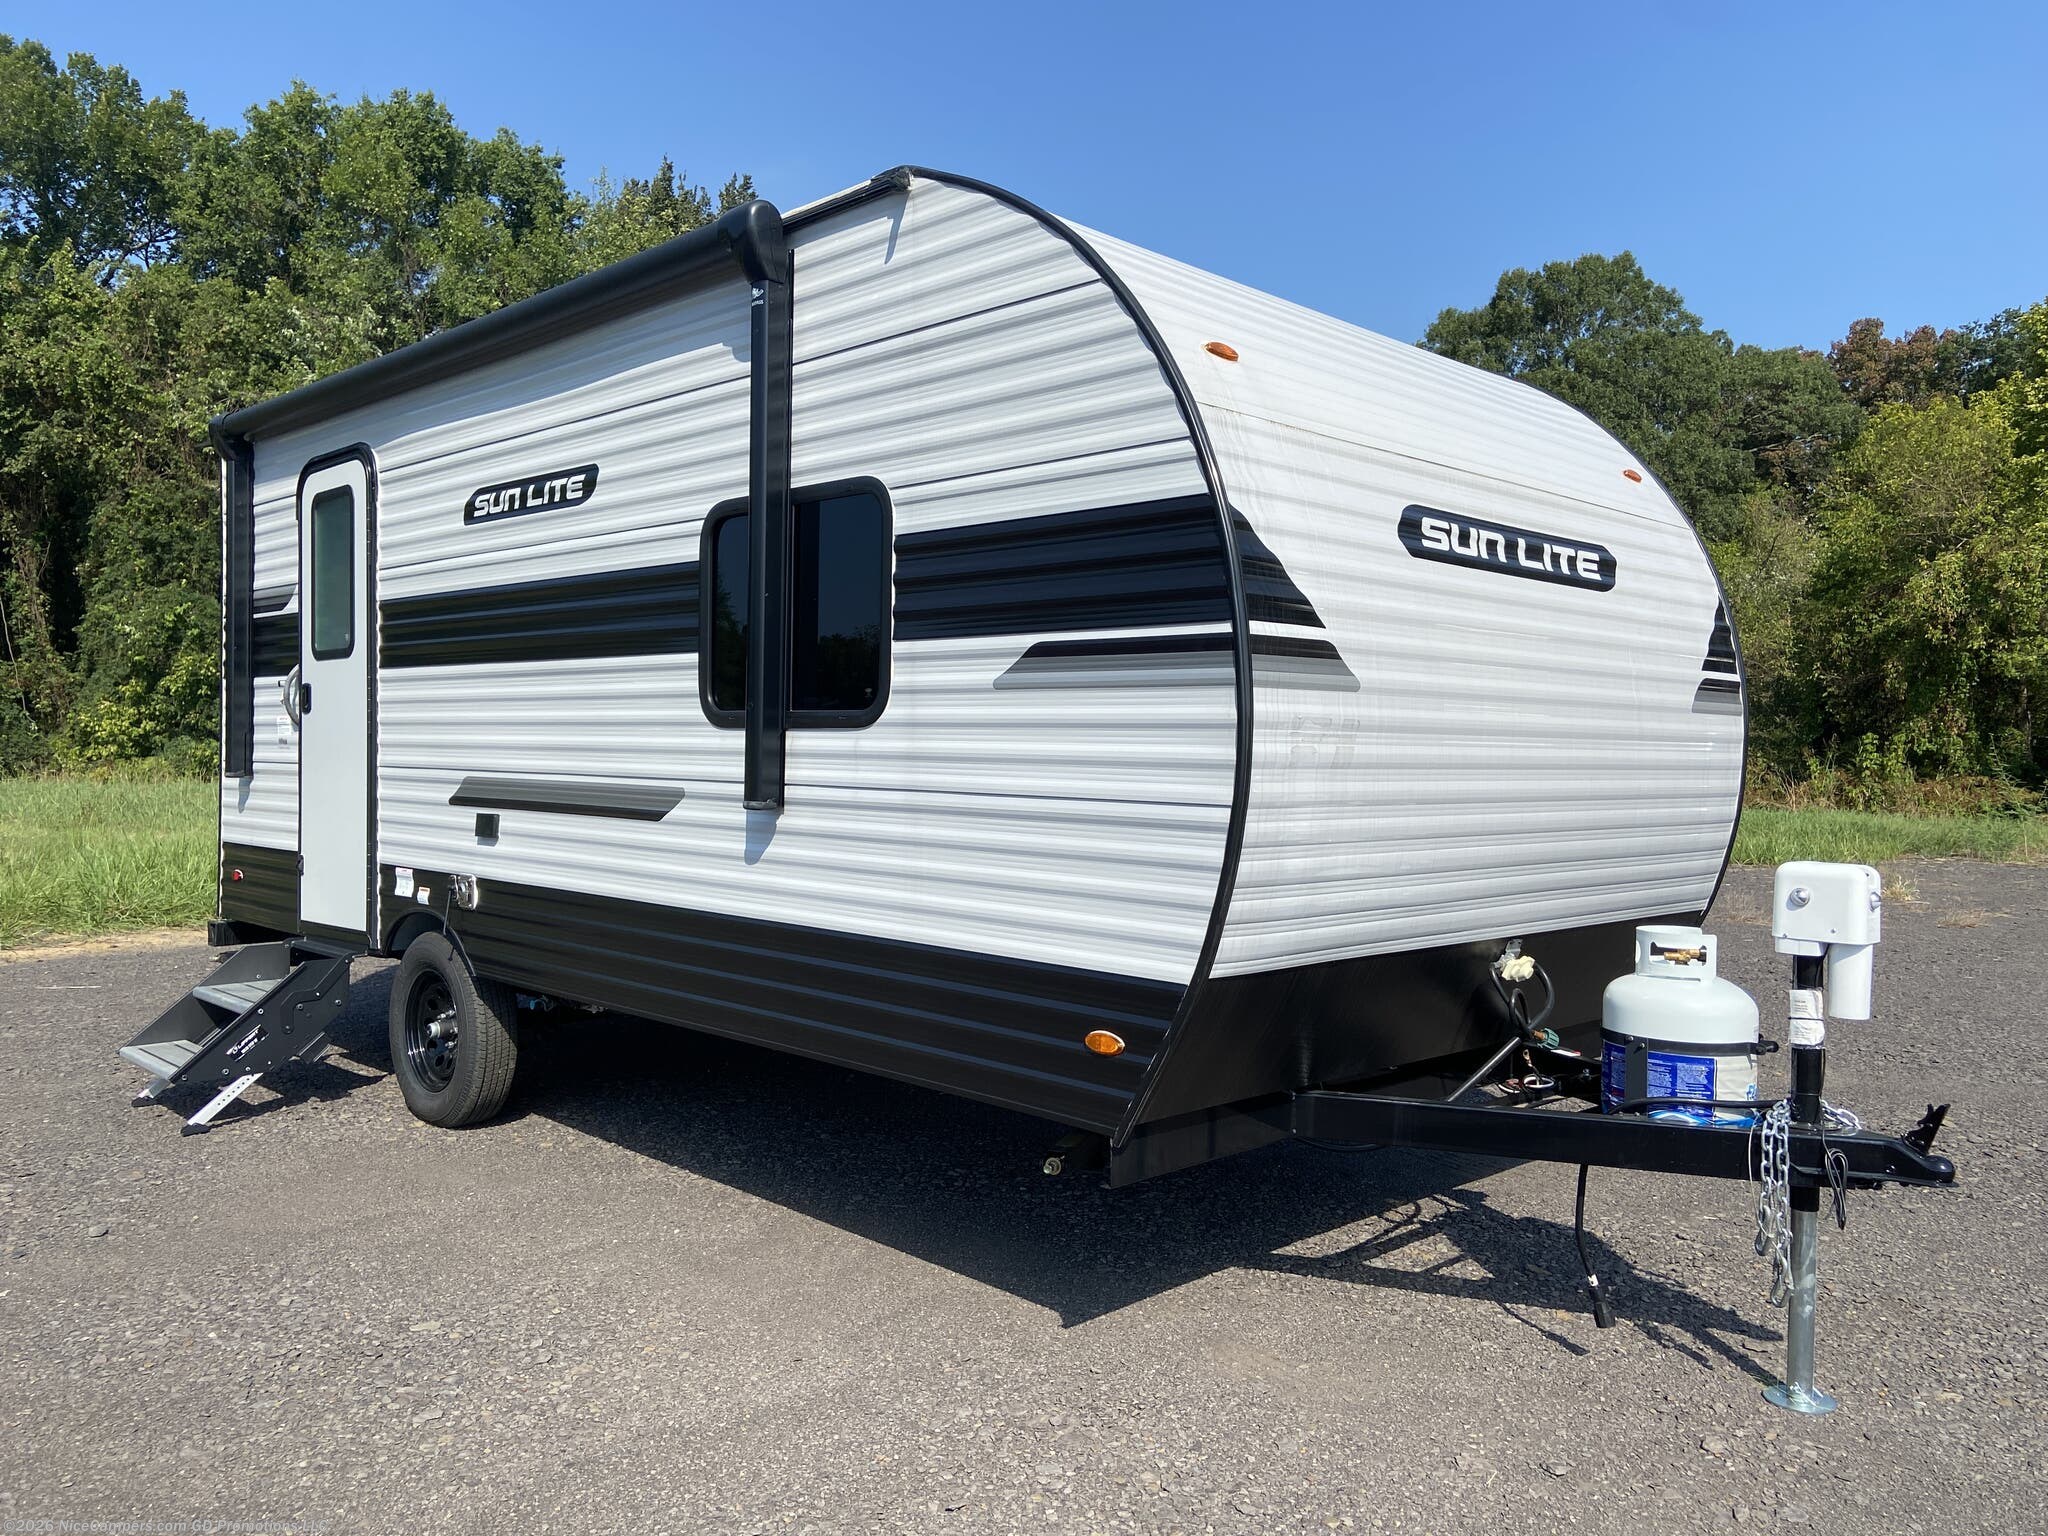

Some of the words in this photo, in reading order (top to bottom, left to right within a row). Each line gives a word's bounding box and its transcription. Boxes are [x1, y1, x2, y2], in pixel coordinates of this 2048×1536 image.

[473, 487, 522, 518] SUN
[526, 474, 587, 507] LITE
[1421, 516, 1508, 563] SUN
[1517, 537, 1602, 581] LITE
